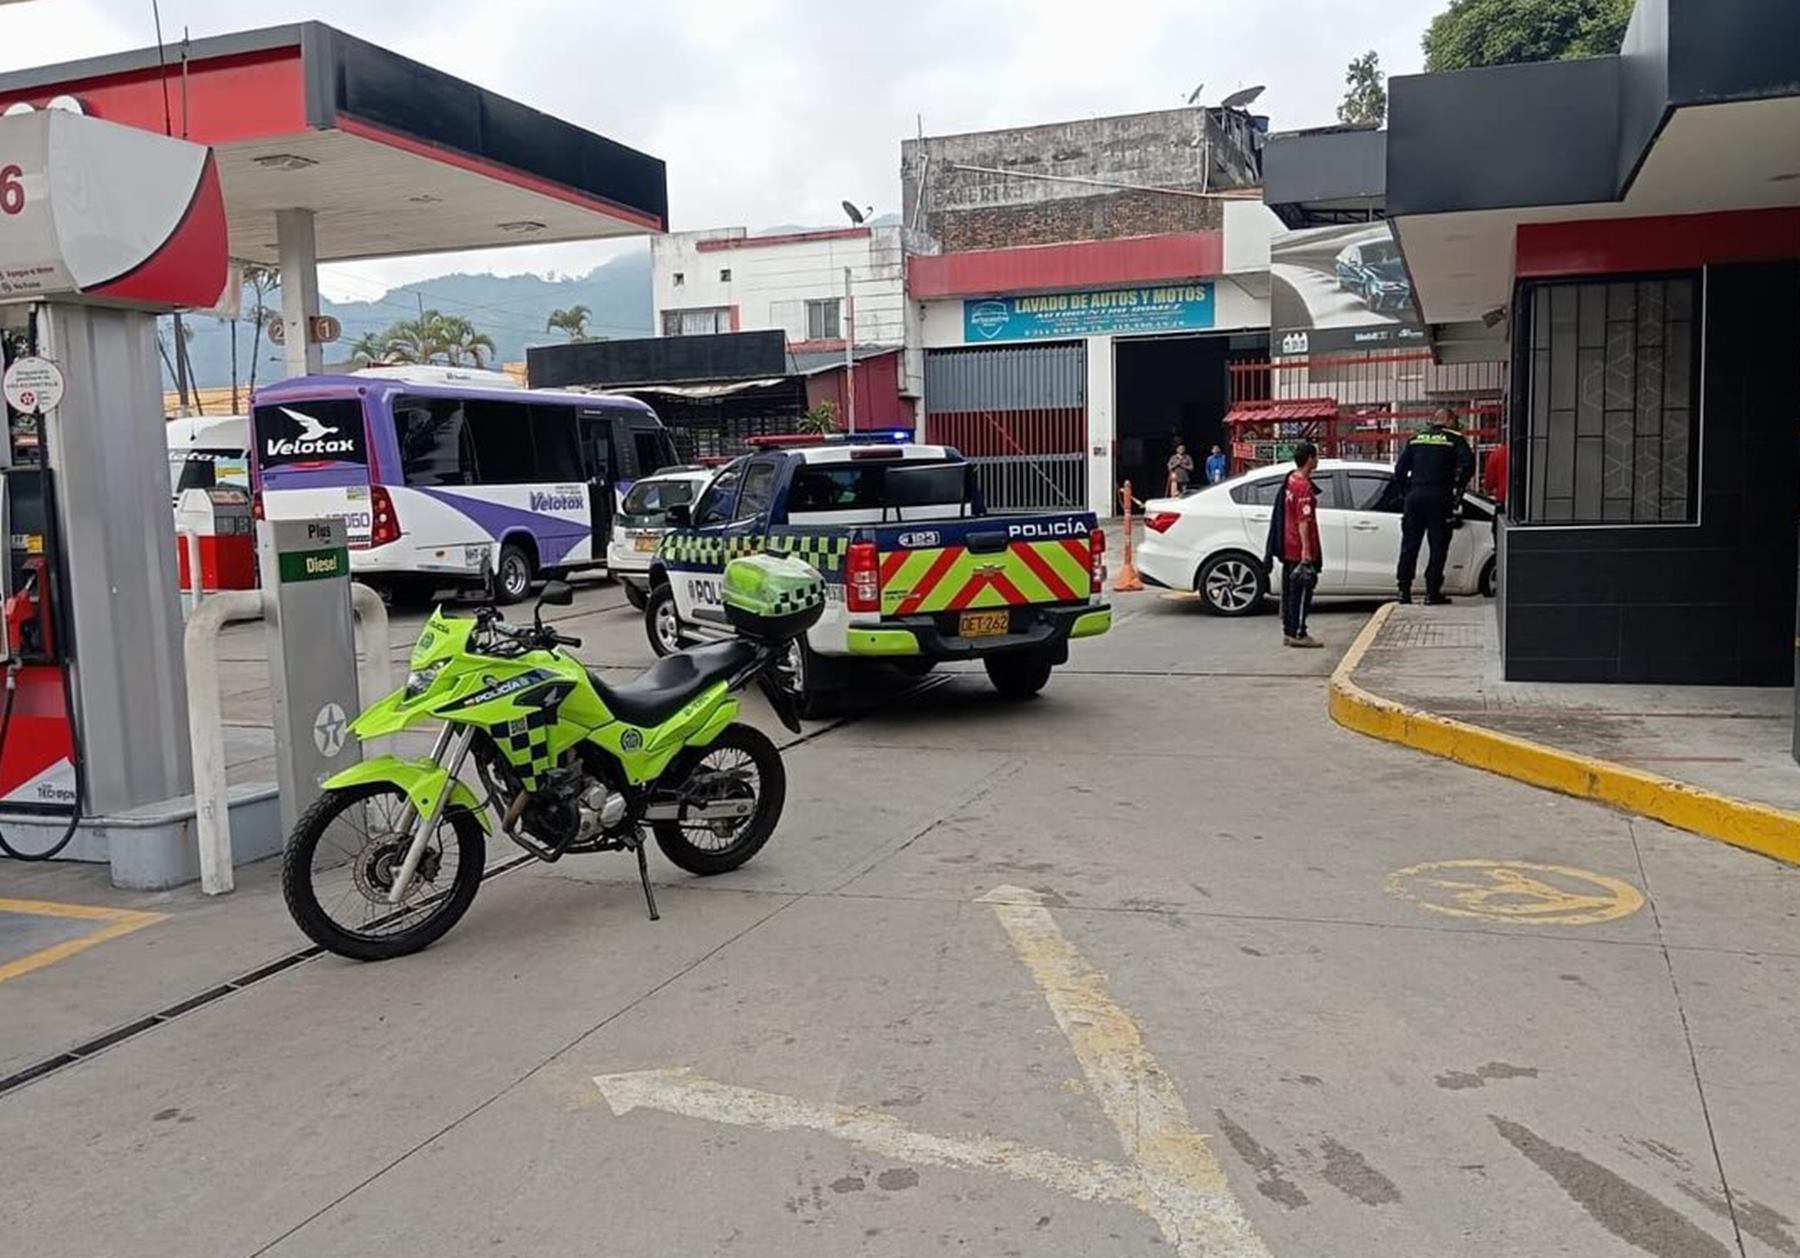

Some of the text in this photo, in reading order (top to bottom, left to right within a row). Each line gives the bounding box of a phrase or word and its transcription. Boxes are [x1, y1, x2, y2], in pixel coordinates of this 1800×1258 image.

[0, 165, 24, 215] 6
[1014, 286, 1206, 314] LAVADO DE AUTOS Y MOTOS
[267, 439, 354, 457] Velotax
[530, 491, 584, 512] Velotax
[308, 523, 331, 539] Plus
[1008, 518, 1088, 538] POLICÍA
[306, 555, 337, 574] Diesel
